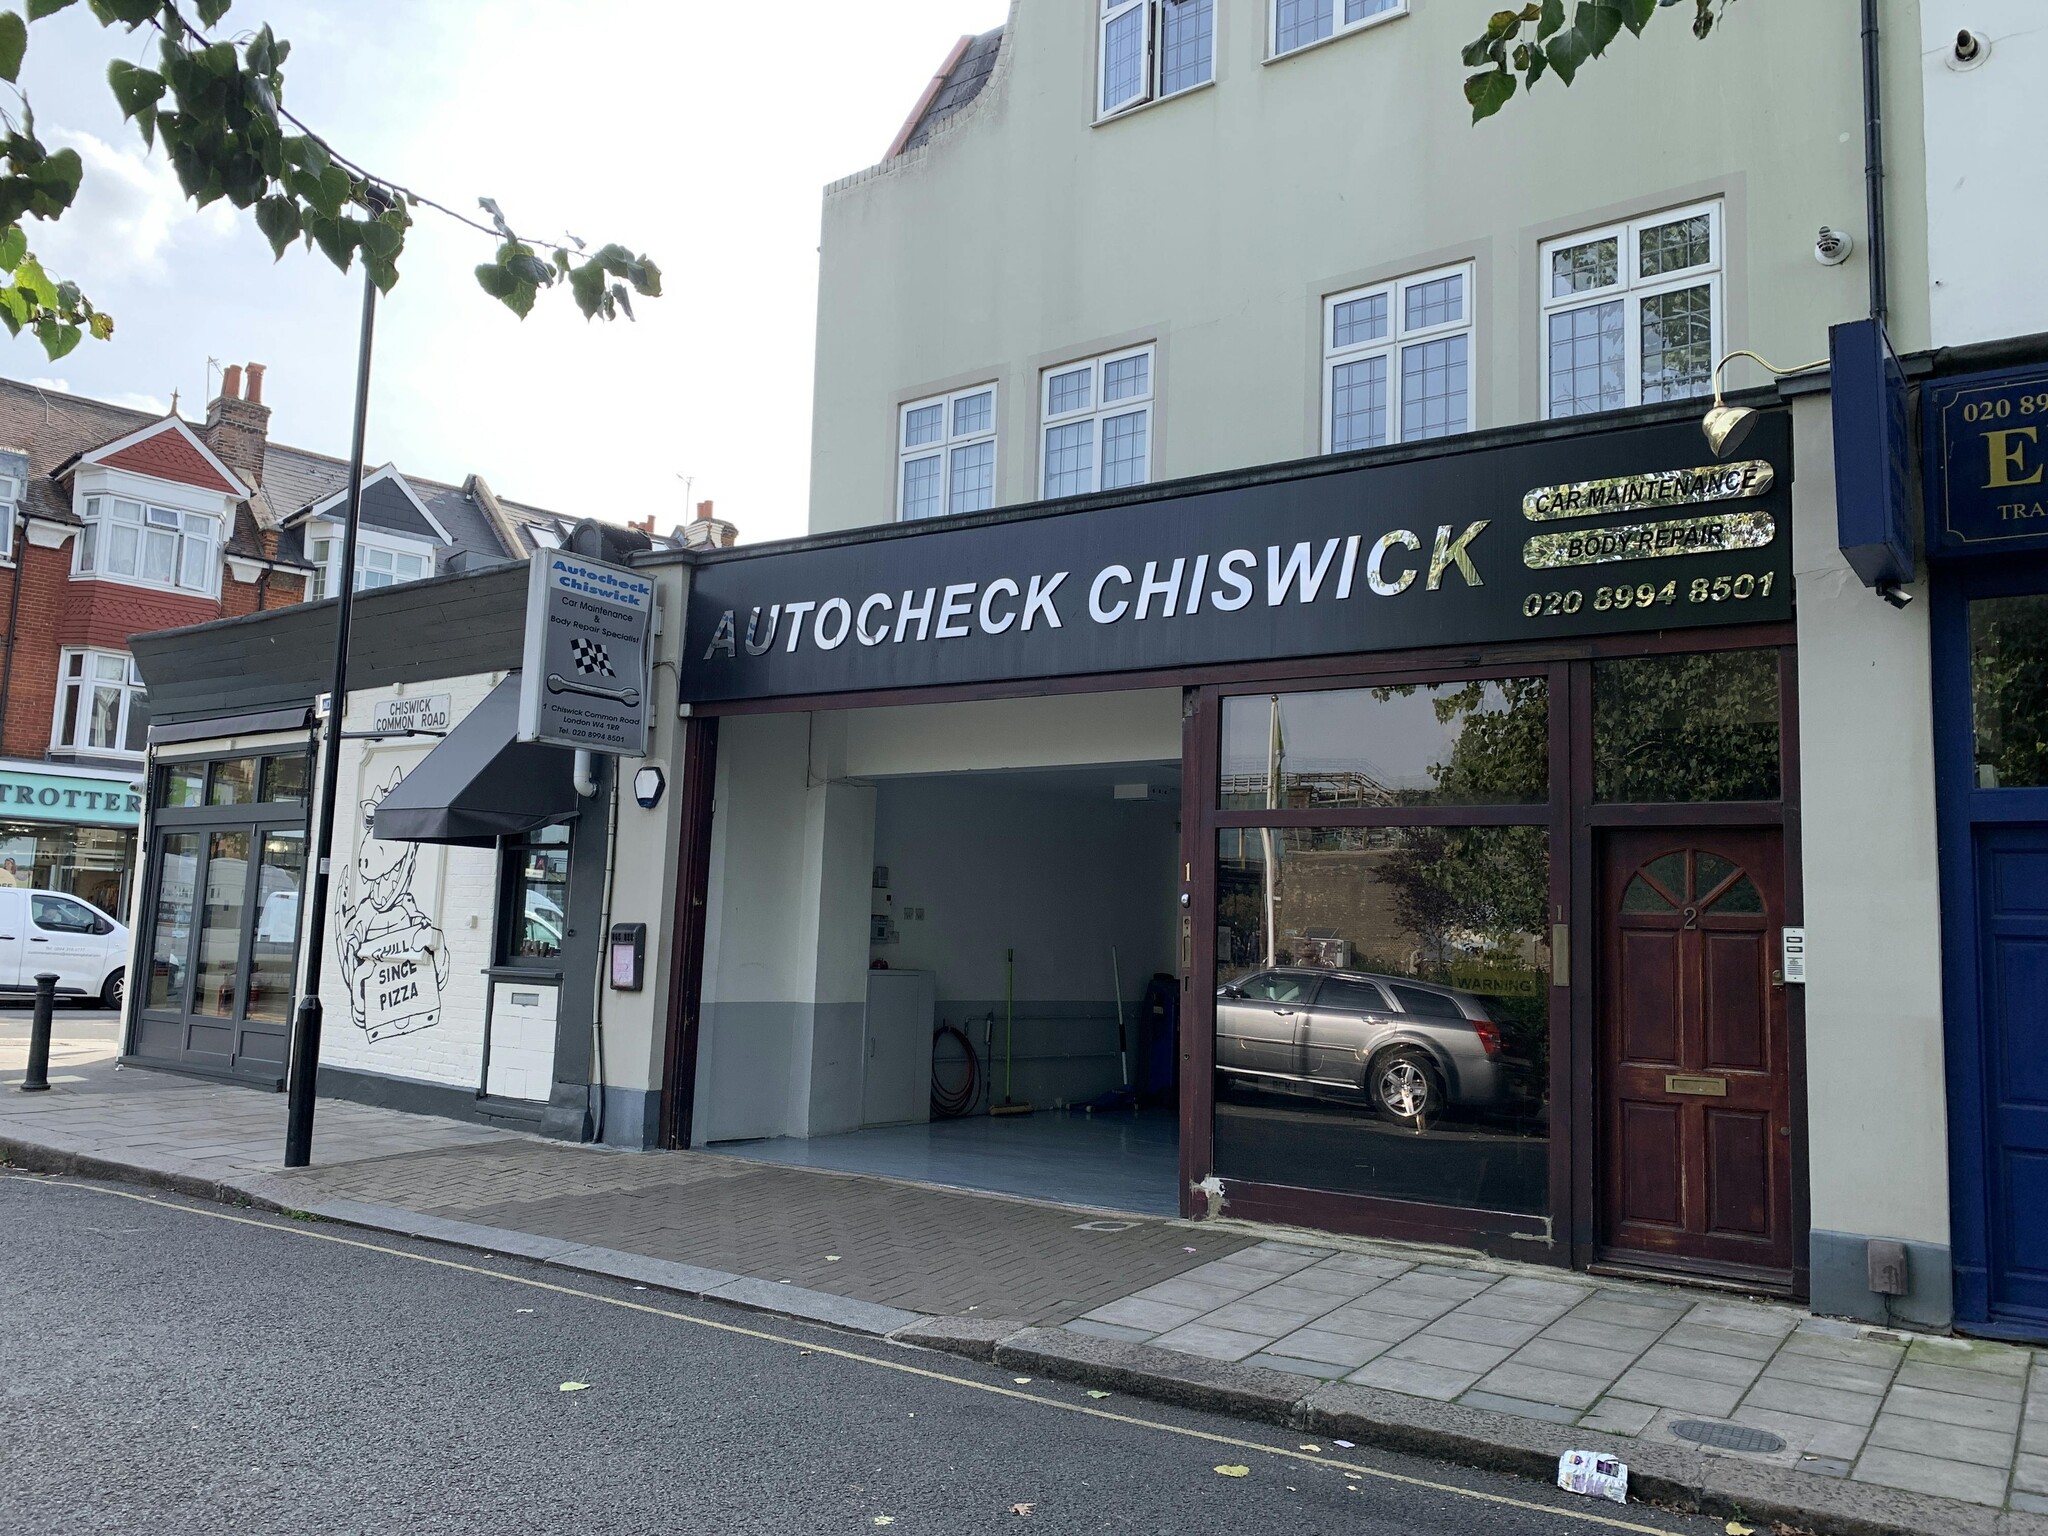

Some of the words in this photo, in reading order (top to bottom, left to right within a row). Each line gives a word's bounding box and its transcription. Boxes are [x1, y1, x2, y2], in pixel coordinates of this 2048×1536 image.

[1963, 399, 2010, 422] 020
[2020, 393, 2048, 415] 89
[1979, 426, 2048, 489] E
[1536, 491, 1581, 514] CAR
[1587, 468, 1758, 508] MAINTENANCE
[1997, 501, 2048, 520] TRA
[1568, 533, 1633, 558] BODY
[1639, 523, 1724, 551] REPAIR
[552, 560, 650, 595] Autocheck
[703, 572, 1069, 661] AUTOCHECK
[1088, 520, 1493, 624] CHISWICK
[559, 576, 641, 606] Chiswick
[1522, 590, 1583, 617] 020
[1593, 580, 1677, 611] 8994
[1689, 571, 1775, 603] 8501
[561, 596, 578, 608] Car
[580, 600, 633, 622] Maintenance
[594, 615, 600, 623] &
[550, 615, 571, 627] Body
[573, 621, 600, 634] Repair
[602, 628, 640, 643] Specialist
[389, 698, 432, 716] CHISWICK
[551, 704, 583, 717] Chiswick
[584, 710, 618, 722] Common
[620, 715, 640, 725] Road
[376, 714, 414, 732] COMMON
[421, 711, 446, 728] ROAD
[563, 716, 591, 727] London
[592, 721, 604, 729] W4
[558, 727, 570, 735] Tel.
[572, 729, 586, 737] 020
[588, 731, 606, 741] 8994
[608, 734, 625, 743] 8501
[1185, 862, 1191, 882] 1
[1683, 907, 1697, 930] 2
[379, 959, 418, 985] SINCE
[1457, 978, 1531, 992] WARNING
[379, 981, 419, 1011] PIZZA
